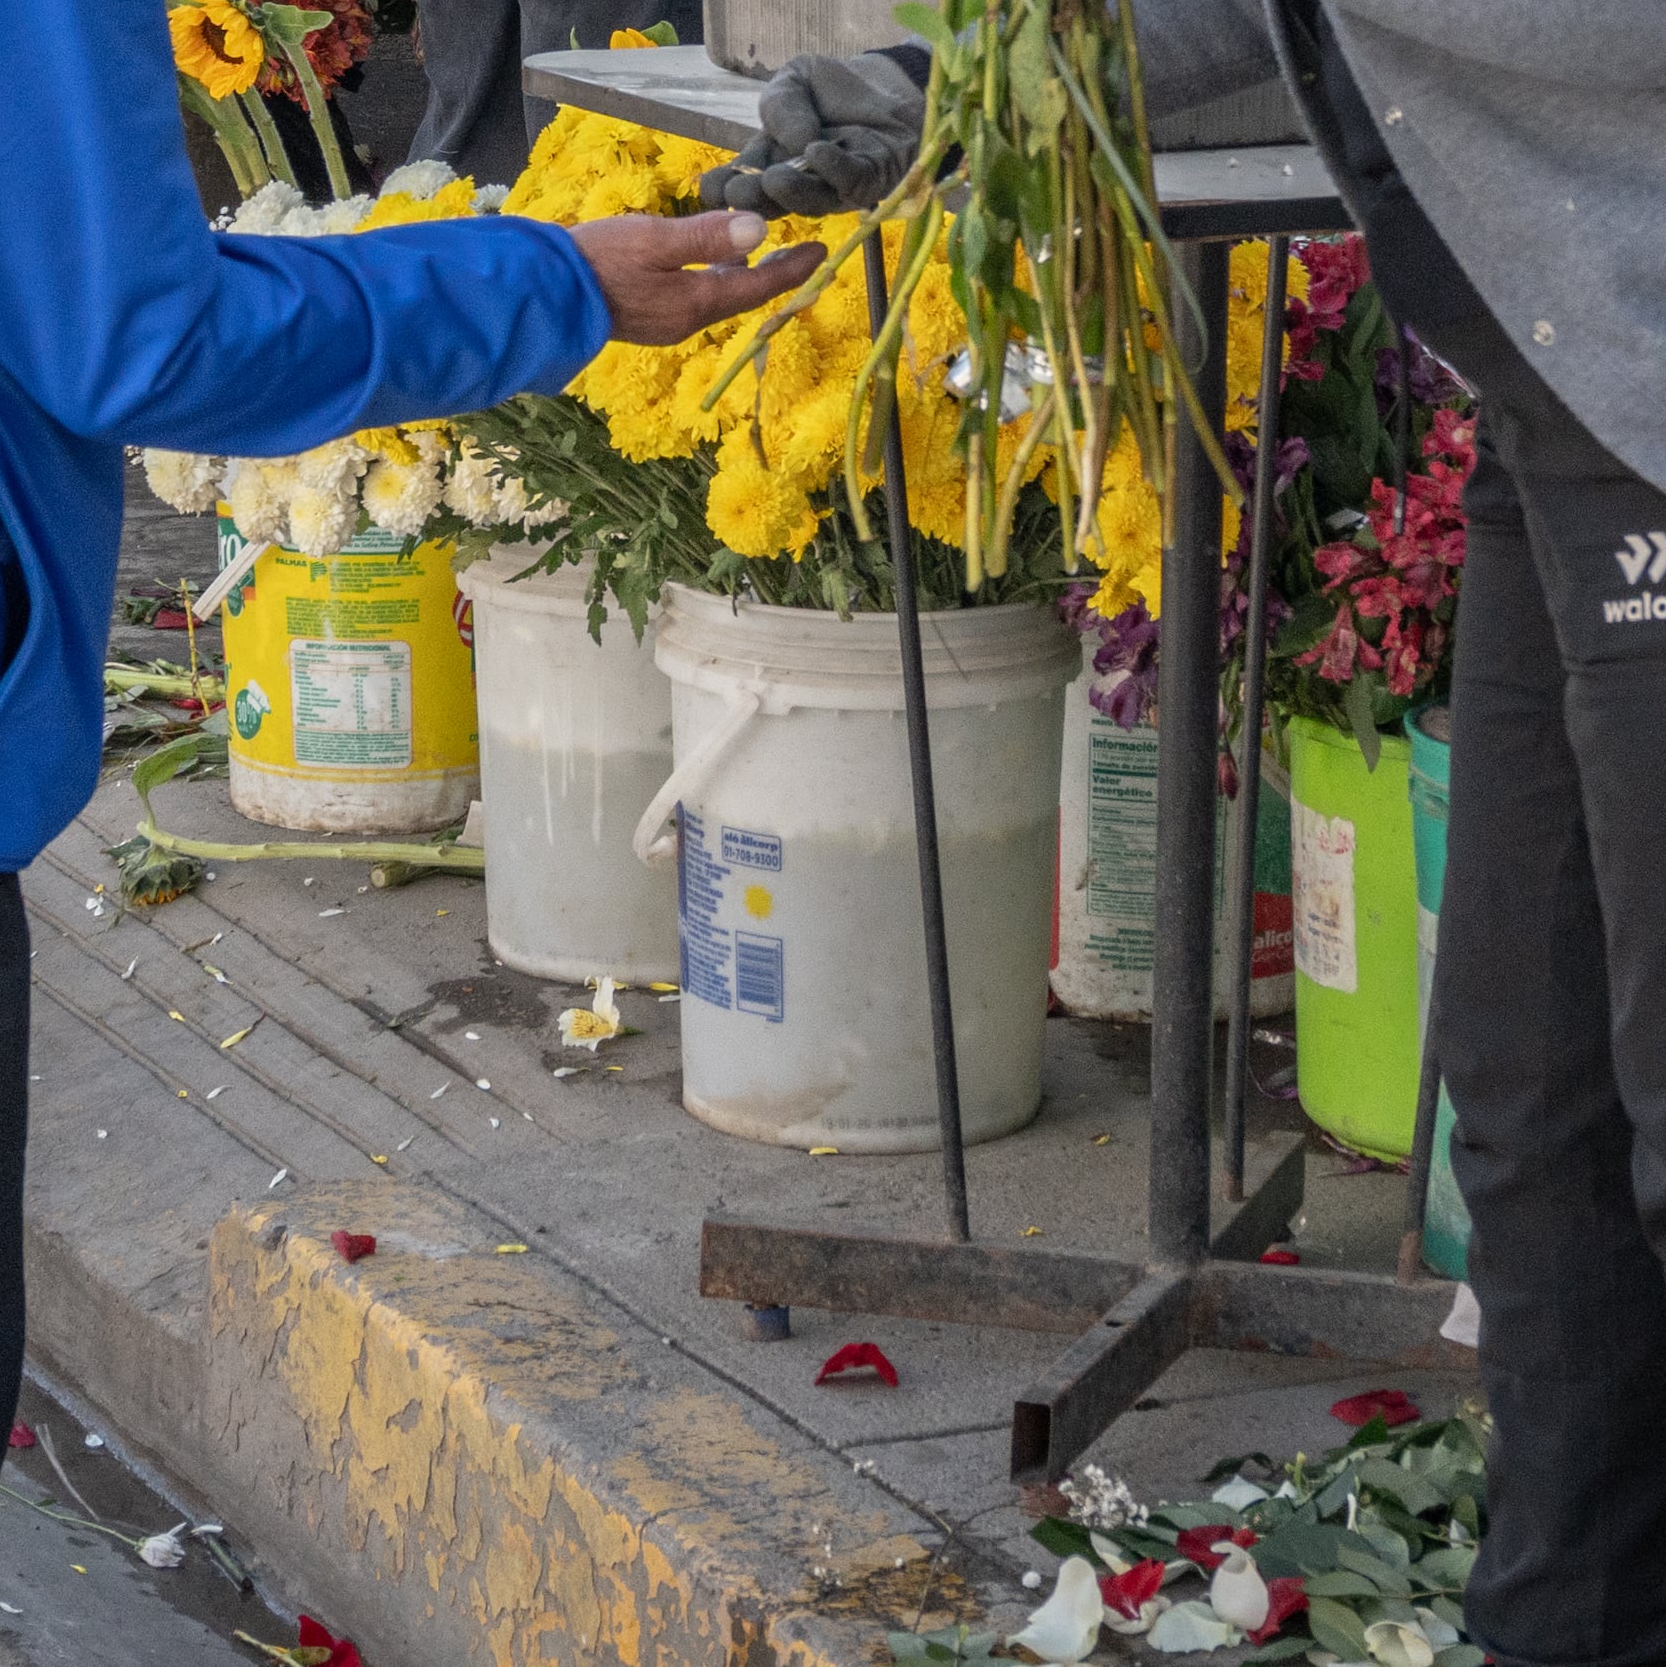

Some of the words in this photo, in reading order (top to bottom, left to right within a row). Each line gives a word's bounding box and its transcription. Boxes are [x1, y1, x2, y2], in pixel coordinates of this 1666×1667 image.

[276, 557, 308, 568] PALMAS
[1093, 774, 1121, 786] Valor
[1092, 786, 1153, 797] energético
[723, 845, 779, 867] 01-708-9300
